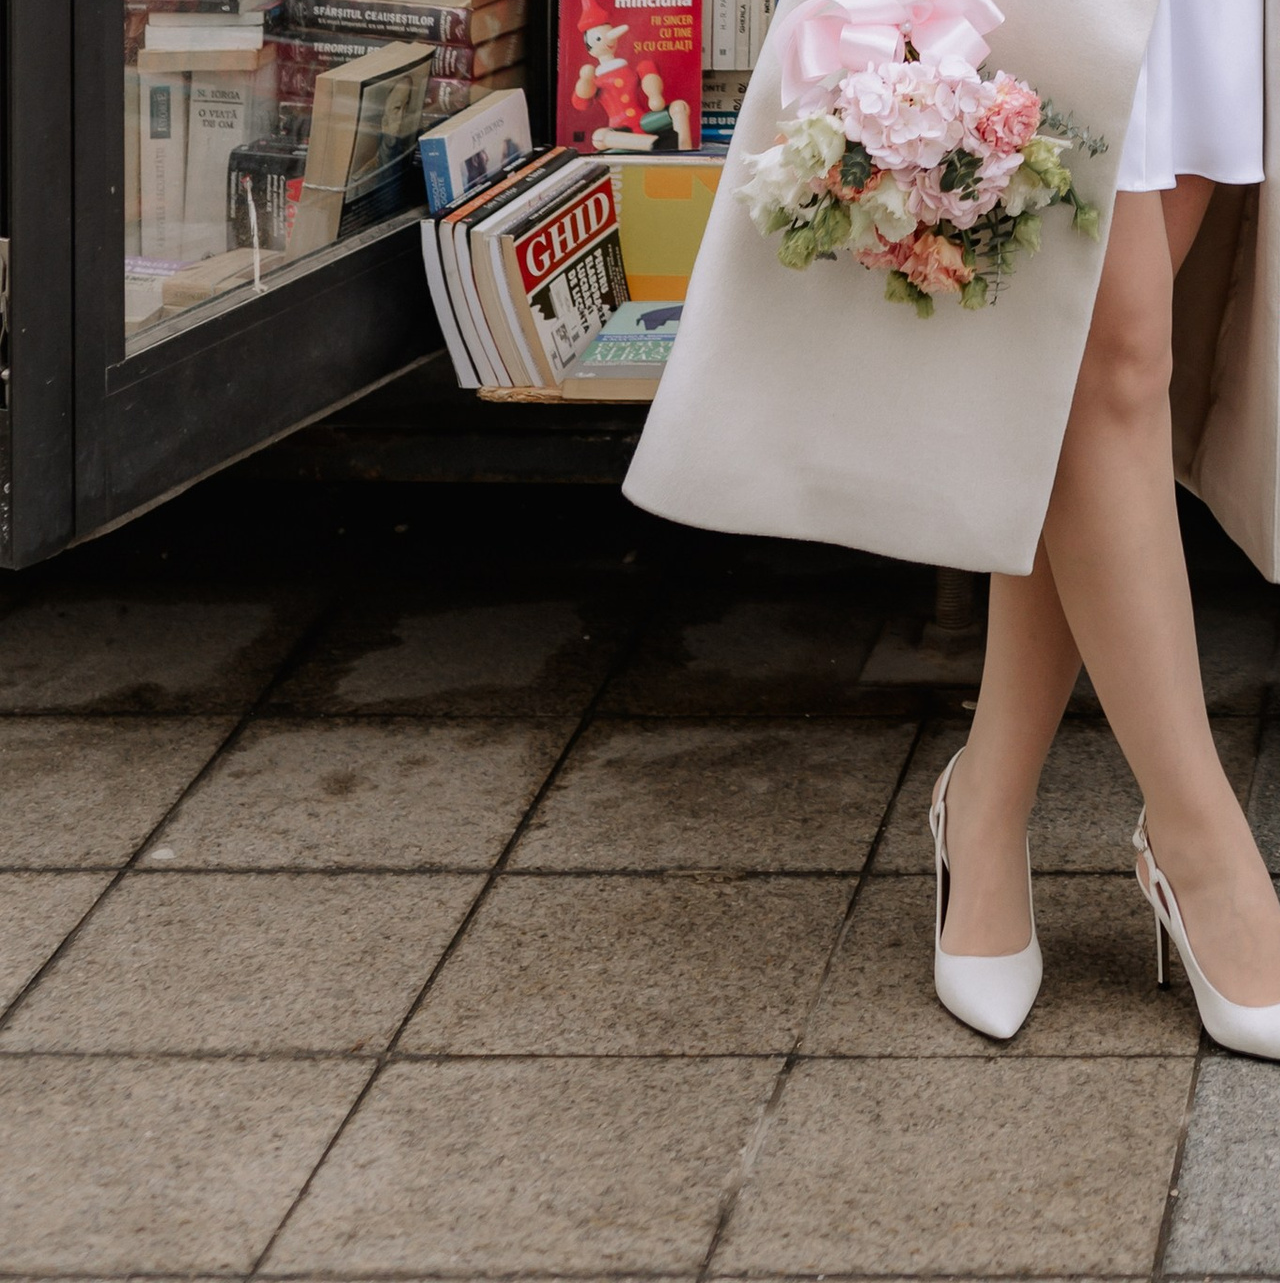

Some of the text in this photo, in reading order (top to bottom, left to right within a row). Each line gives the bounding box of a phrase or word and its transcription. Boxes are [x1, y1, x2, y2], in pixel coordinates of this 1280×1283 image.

[662, 15, 693, 25] SINCER
[660, 27, 692, 38] CU TINE
[643, 42, 656, 51] CU
[526, 191, 610, 277] GHID
